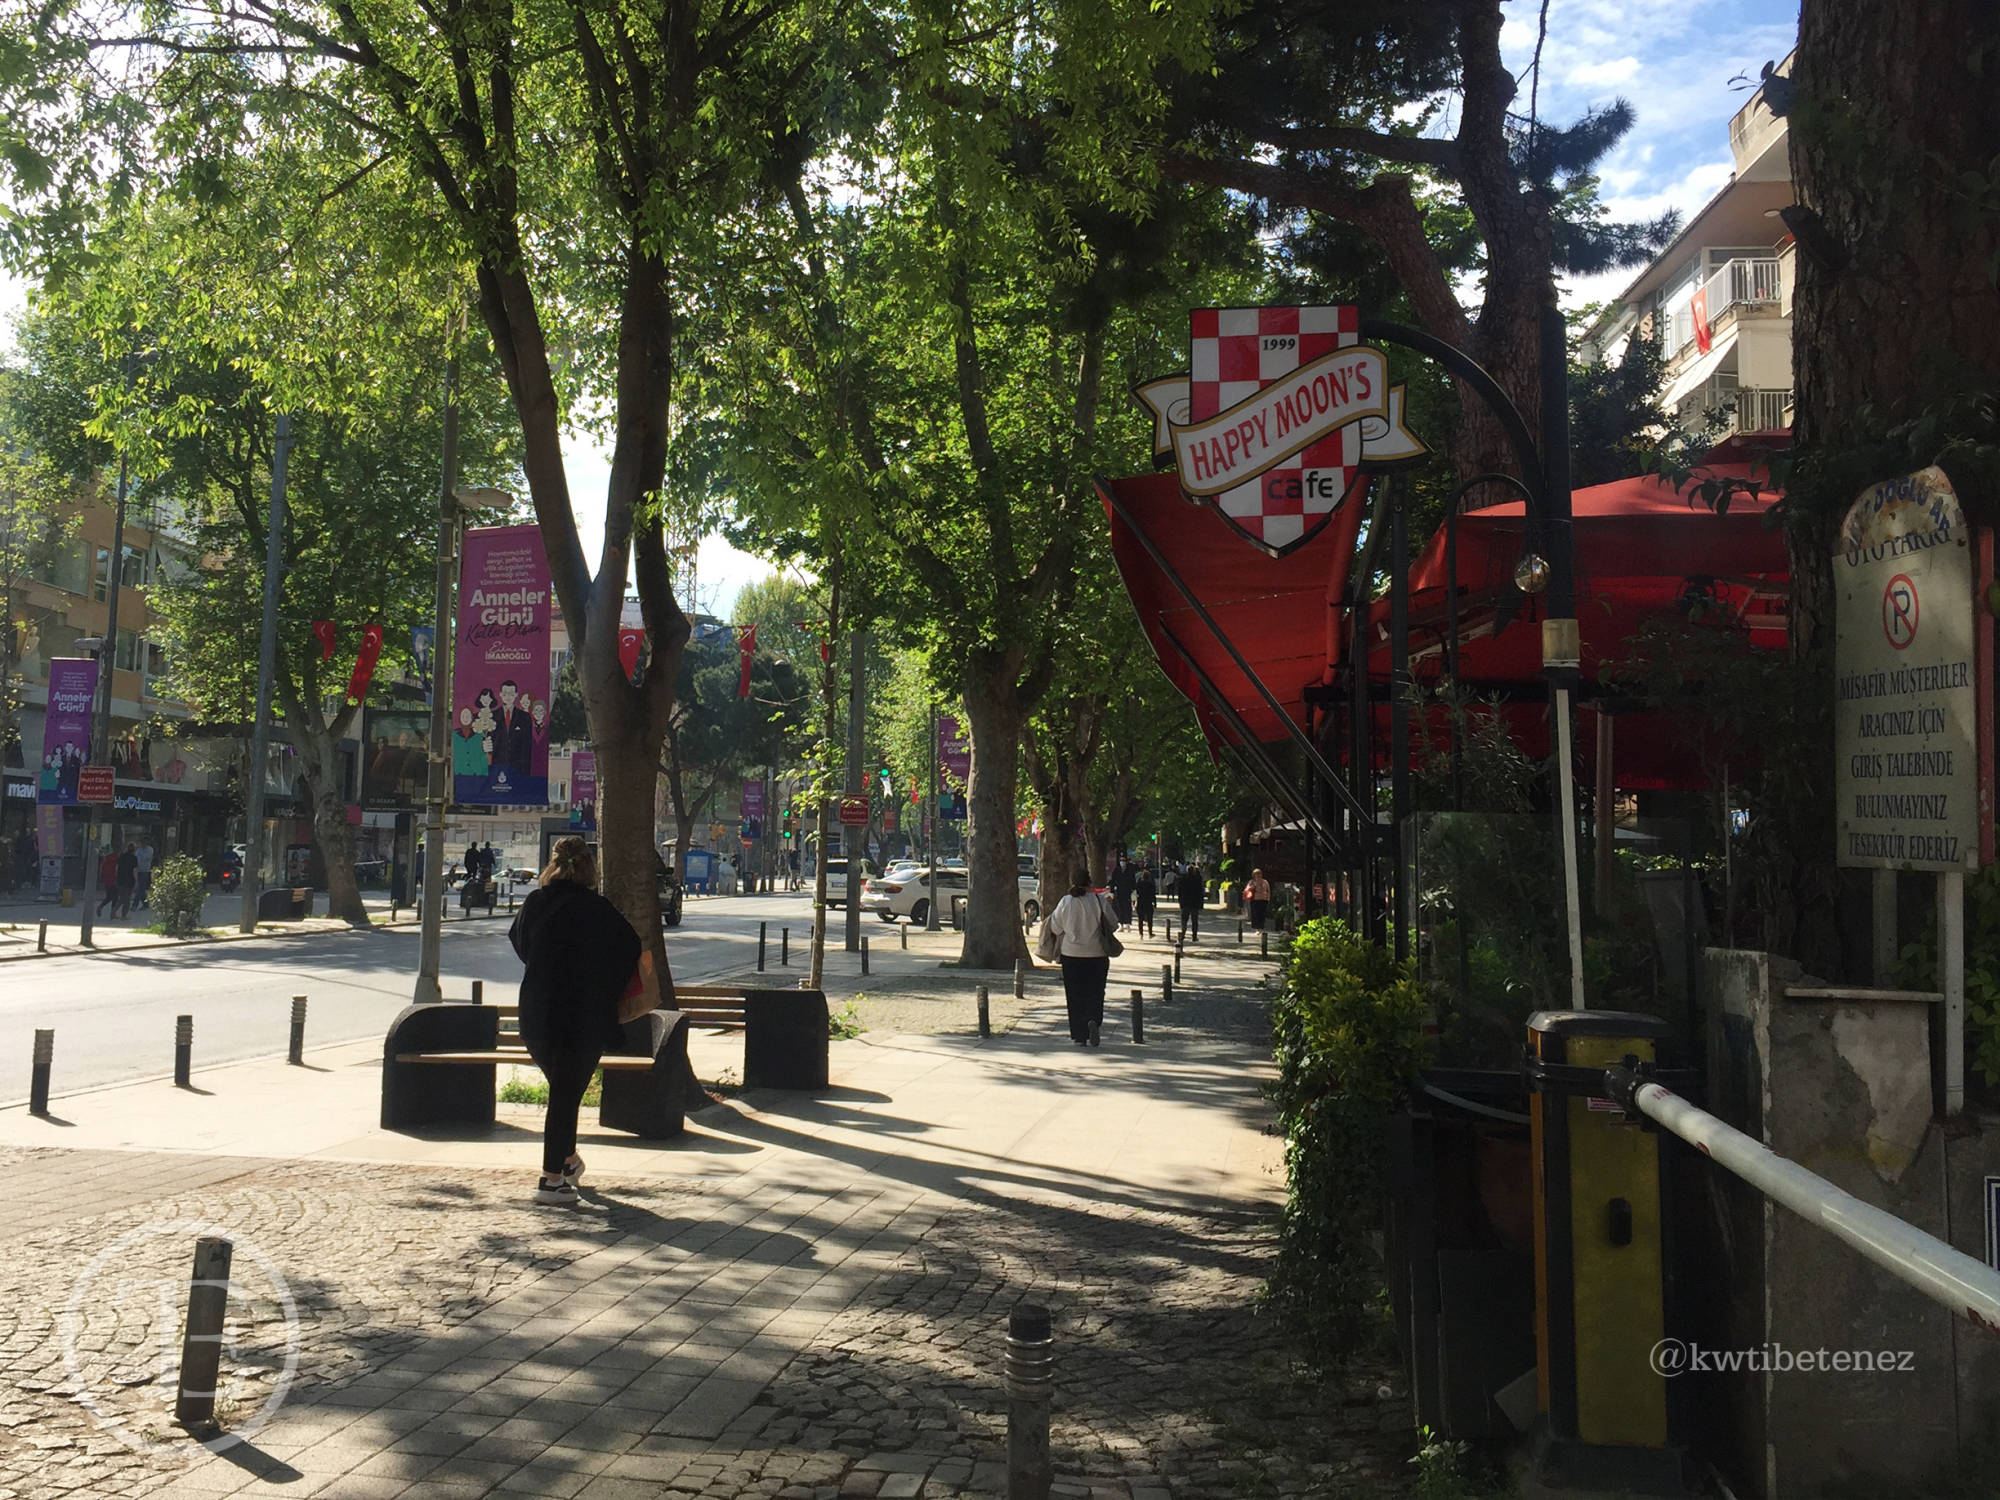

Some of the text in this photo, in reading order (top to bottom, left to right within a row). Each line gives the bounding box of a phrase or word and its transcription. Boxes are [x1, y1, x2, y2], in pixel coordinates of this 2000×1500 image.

[1262, 338, 1297, 351] 1999
[1189, 361, 1372, 481] HAPPY MOON'S
[470, 587, 546, 607] Anneler
[481, 606, 533, 625] Günü
[52, 691, 92, 702] Anneler
[58, 702, 85, 713] Günü
[1858, 711, 1914, 738] ARACINIZ
[1887, 745, 1953, 777] TALEBİNDE
[8, 781, 36, 798] mavi
[1855, 794, 1948, 820] BULUNMAYINIZ
[1909, 830, 1960, 862] EDERİZ
